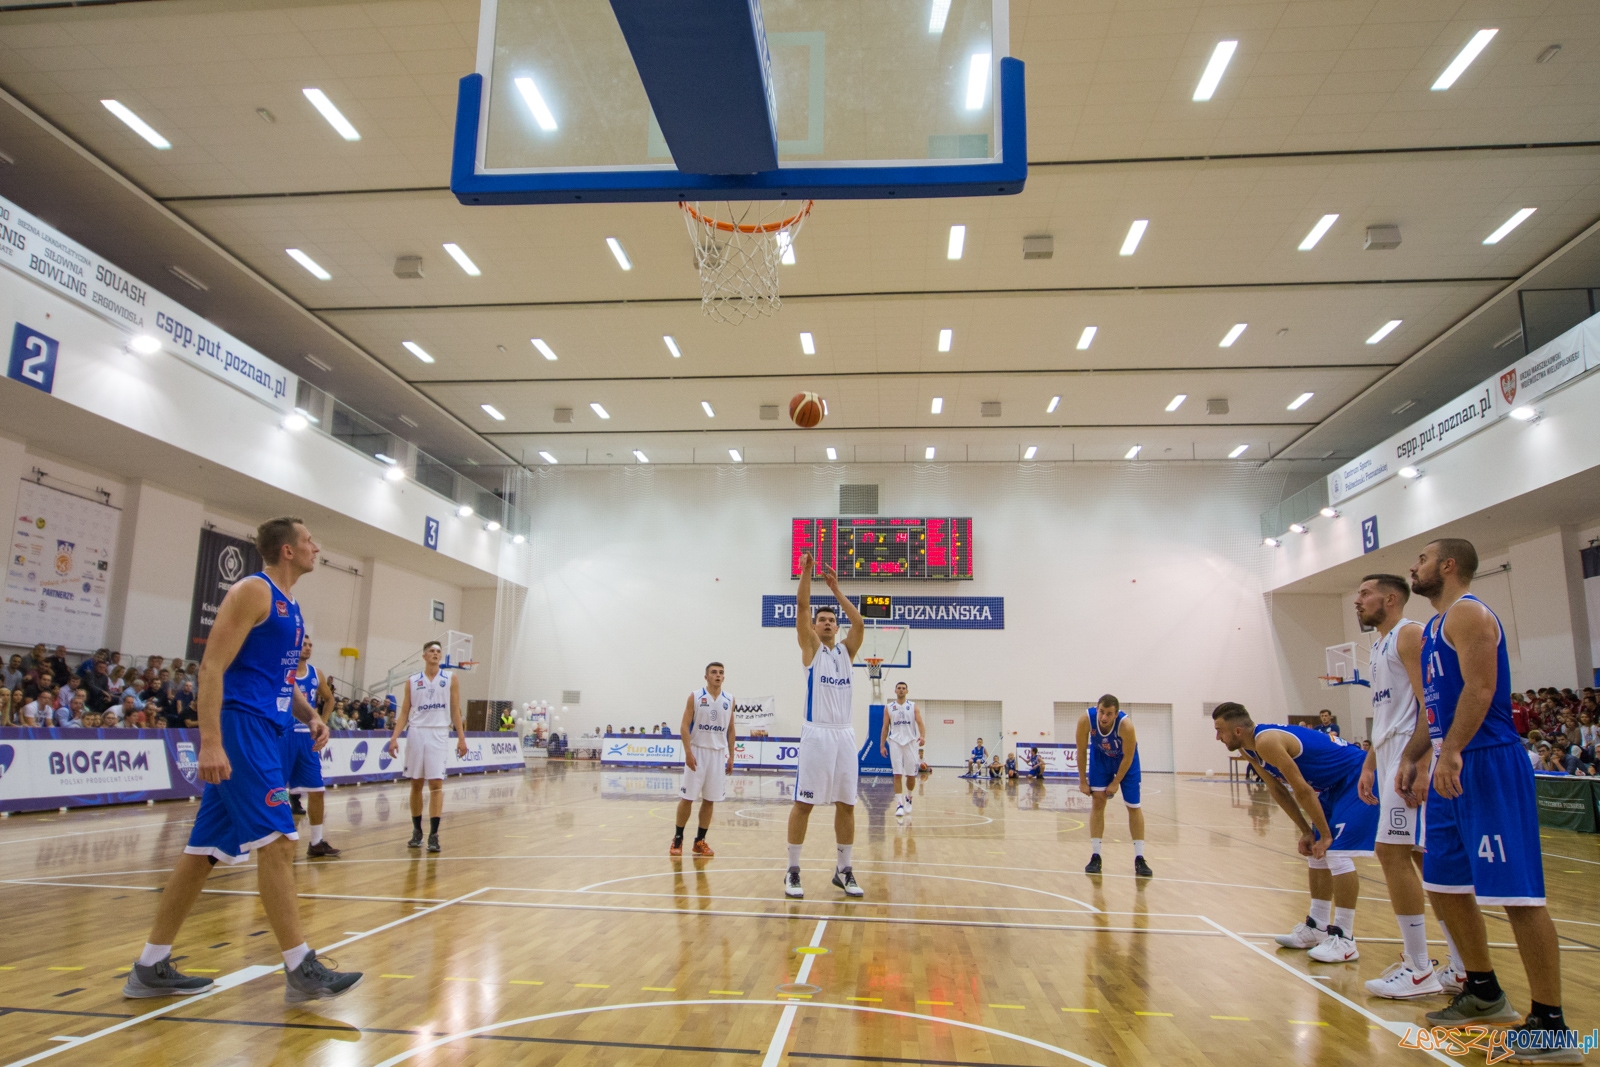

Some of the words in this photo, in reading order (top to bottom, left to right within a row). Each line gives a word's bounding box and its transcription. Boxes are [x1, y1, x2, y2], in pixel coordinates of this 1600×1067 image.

[29, 253, 87, 297] BOWLING
[44, 247, 83, 277] SIŁOWNIA
[95, 264, 146, 307] SQUASH
[91, 290, 144, 328] ERGOWIOSŁA
[21, 335, 48, 384] 2
[155, 310, 287, 398] cspp.put.poznan.pl
[1396, 388, 1492, 459] cspp.put.poznan.pl
[428, 520, 437, 546] 3
[1365, 520, 1374, 548] 3
[894, 602, 993, 620] POZNAŃSKA
[710, 709, 718, 721] 3
[48, 750, 149, 775] BIOFARM
[626, 744, 675, 754] funclub
[86, 776, 121, 784] PRODUCENT
[1335, 822, 1346, 840] 7
[1389, 807, 1407, 829] 6
[1477, 833, 1506, 863] 41
